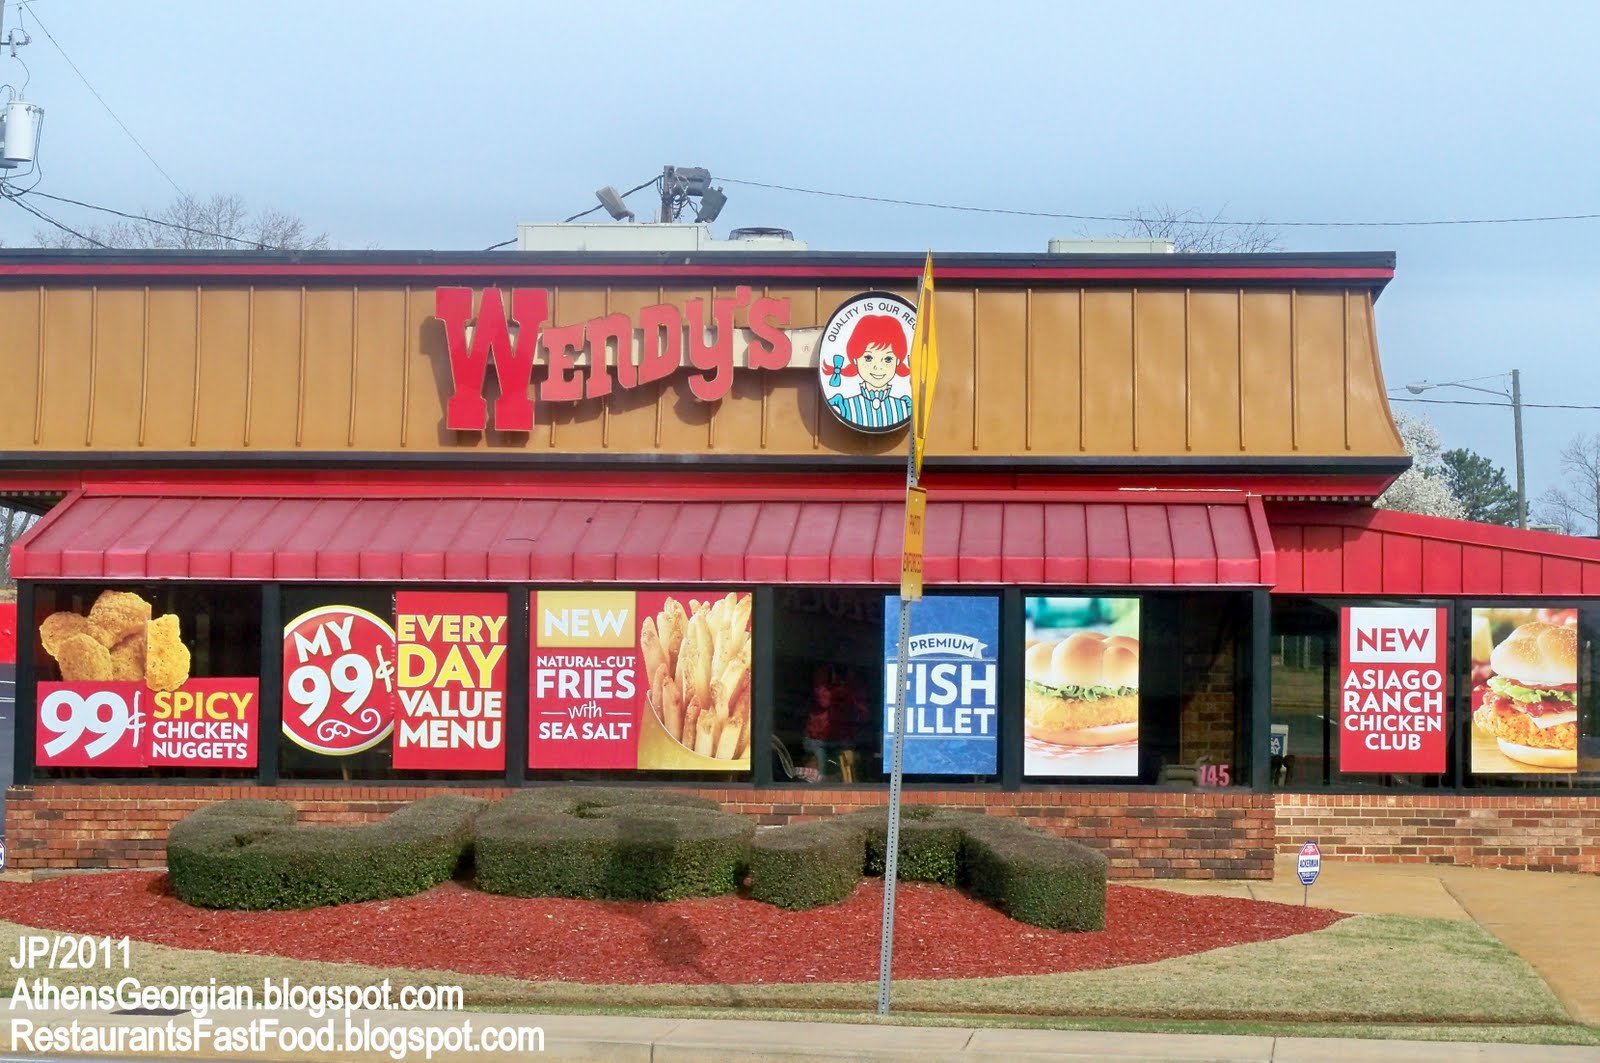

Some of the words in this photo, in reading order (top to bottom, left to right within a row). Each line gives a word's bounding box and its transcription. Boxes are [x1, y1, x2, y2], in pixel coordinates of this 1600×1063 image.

[828, 307, 859, 342] QUALITY
[864, 303, 873, 311] IS
[879, 302, 899, 314] OUR
[397, 615, 507, 642] EVERY
[544, 609, 628, 638] NEW
[293, 616, 354, 662] MY
[910, 638, 974, 652] PREMIUM
[1356, 628, 1430, 652] NEW
[397, 644, 507, 688] DAY
[536, 655, 635, 668] NATURAL-CUT
[536, 669, 636, 699] FRIES
[886, 663, 996, 706] FISH
[1343, 669, 1442, 690] ASIAGO
[153, 692, 253, 720] SPICY
[397, 690, 502, 718] VALUE
[568, 701, 602, 719] with
[1343, 691, 1443, 713] RANCH
[153, 721, 248, 740] CHICKEN
[399, 720, 502, 749] MENU
[538, 722, 579, 740] SEA
[582, 722, 632, 740] SALT
[1344, 714, 1442, 732] CHICKEN
[153, 742, 247, 759] NUGGETS
[1365, 733, 1422, 751] CLUB
[1200, 764, 1230, 786] 145
